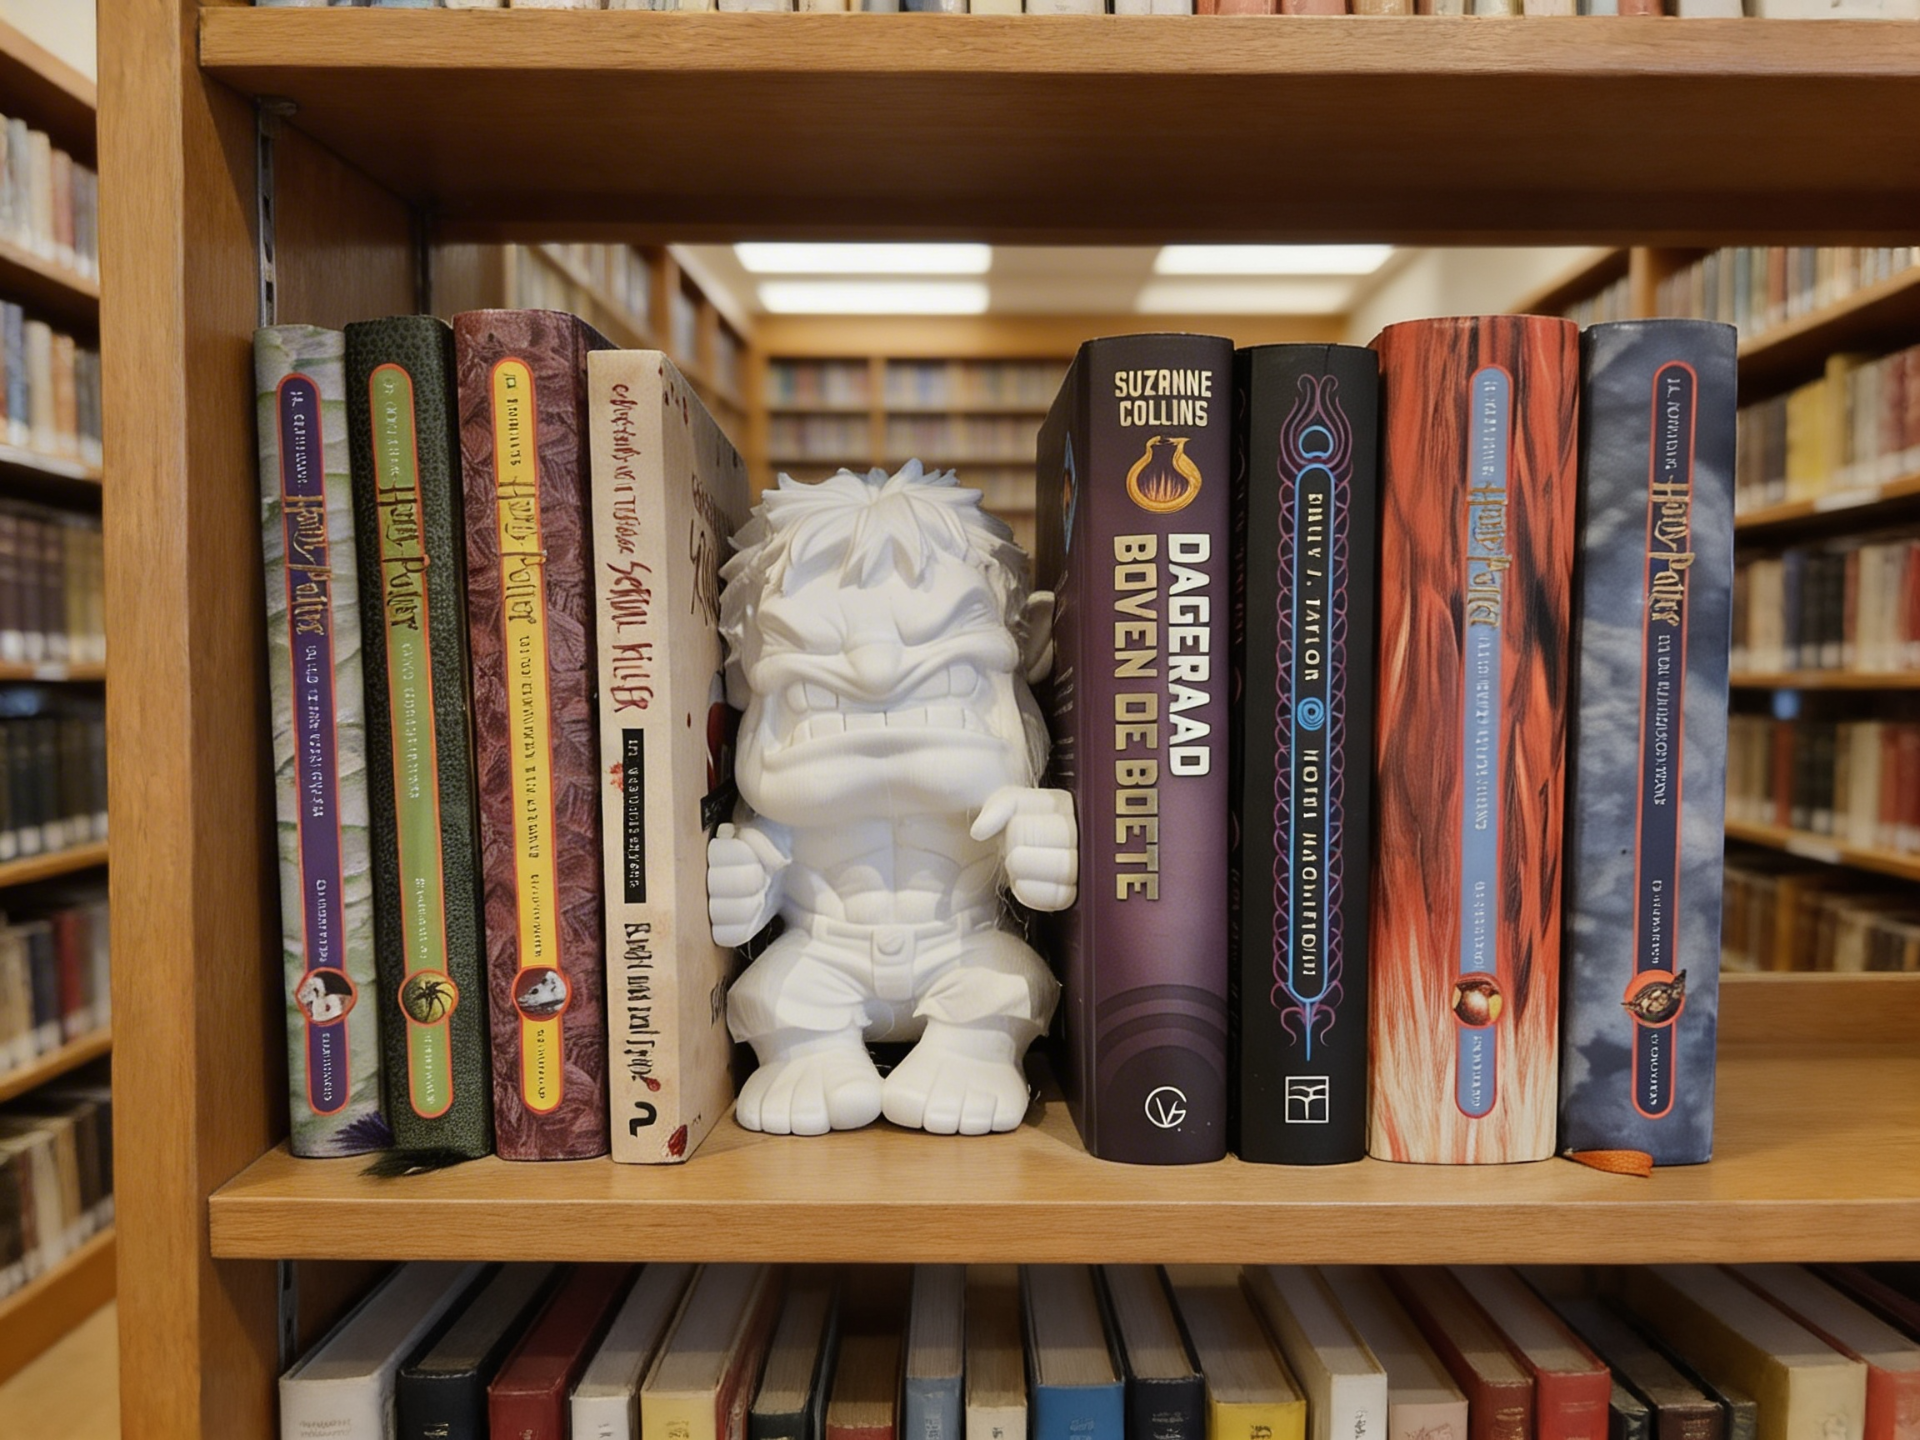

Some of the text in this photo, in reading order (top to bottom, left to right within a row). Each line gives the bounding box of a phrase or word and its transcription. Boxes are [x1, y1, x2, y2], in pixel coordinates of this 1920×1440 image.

[1114, 370, 1212, 398] SUZANNE
[1119, 400, 1208, 427] COLLINS
[1114, 534, 1158, 677] BOVEN
[1168, 533, 1211, 776] DAGERAAD
[1115, 760, 1159, 900] BOETE
